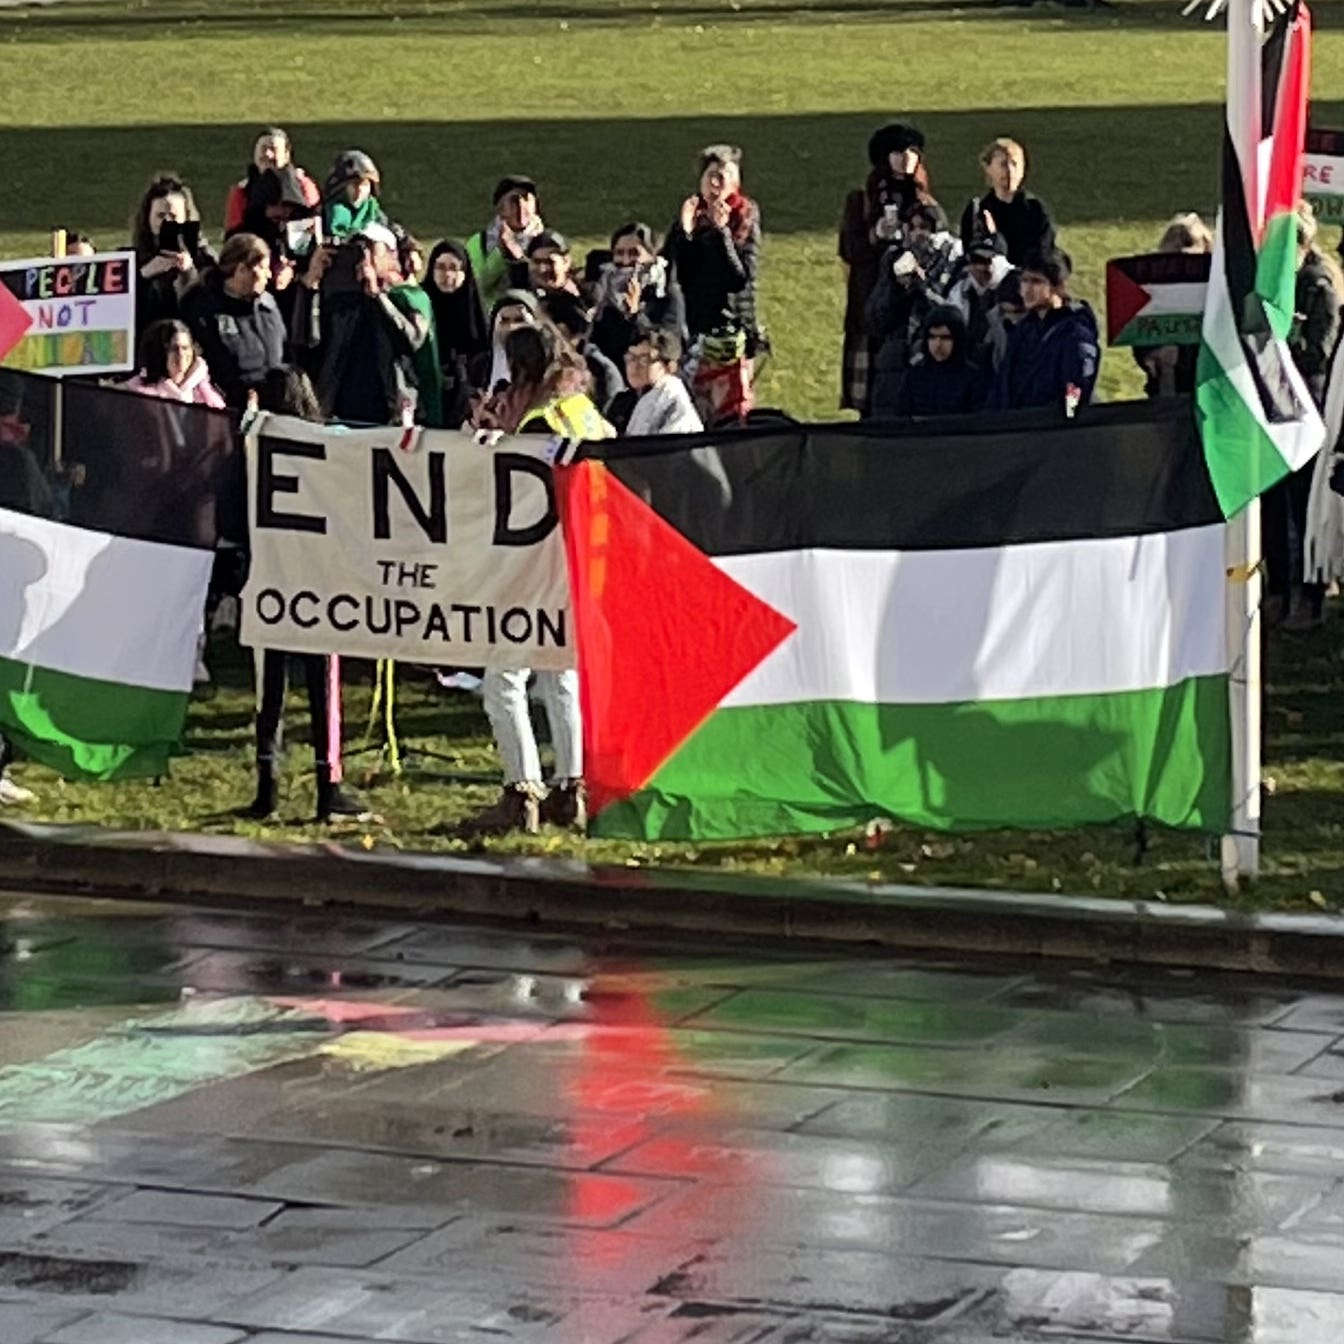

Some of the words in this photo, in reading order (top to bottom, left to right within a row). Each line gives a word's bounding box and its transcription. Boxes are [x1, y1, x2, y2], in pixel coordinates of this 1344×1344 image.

[25, 260, 124, 299] PEOPLE
[38, 299, 97, 329] NOT
[256, 435, 561, 547] END
[375, 559, 439, 589] THE
[255, 587, 568, 648] OCCUPATION
